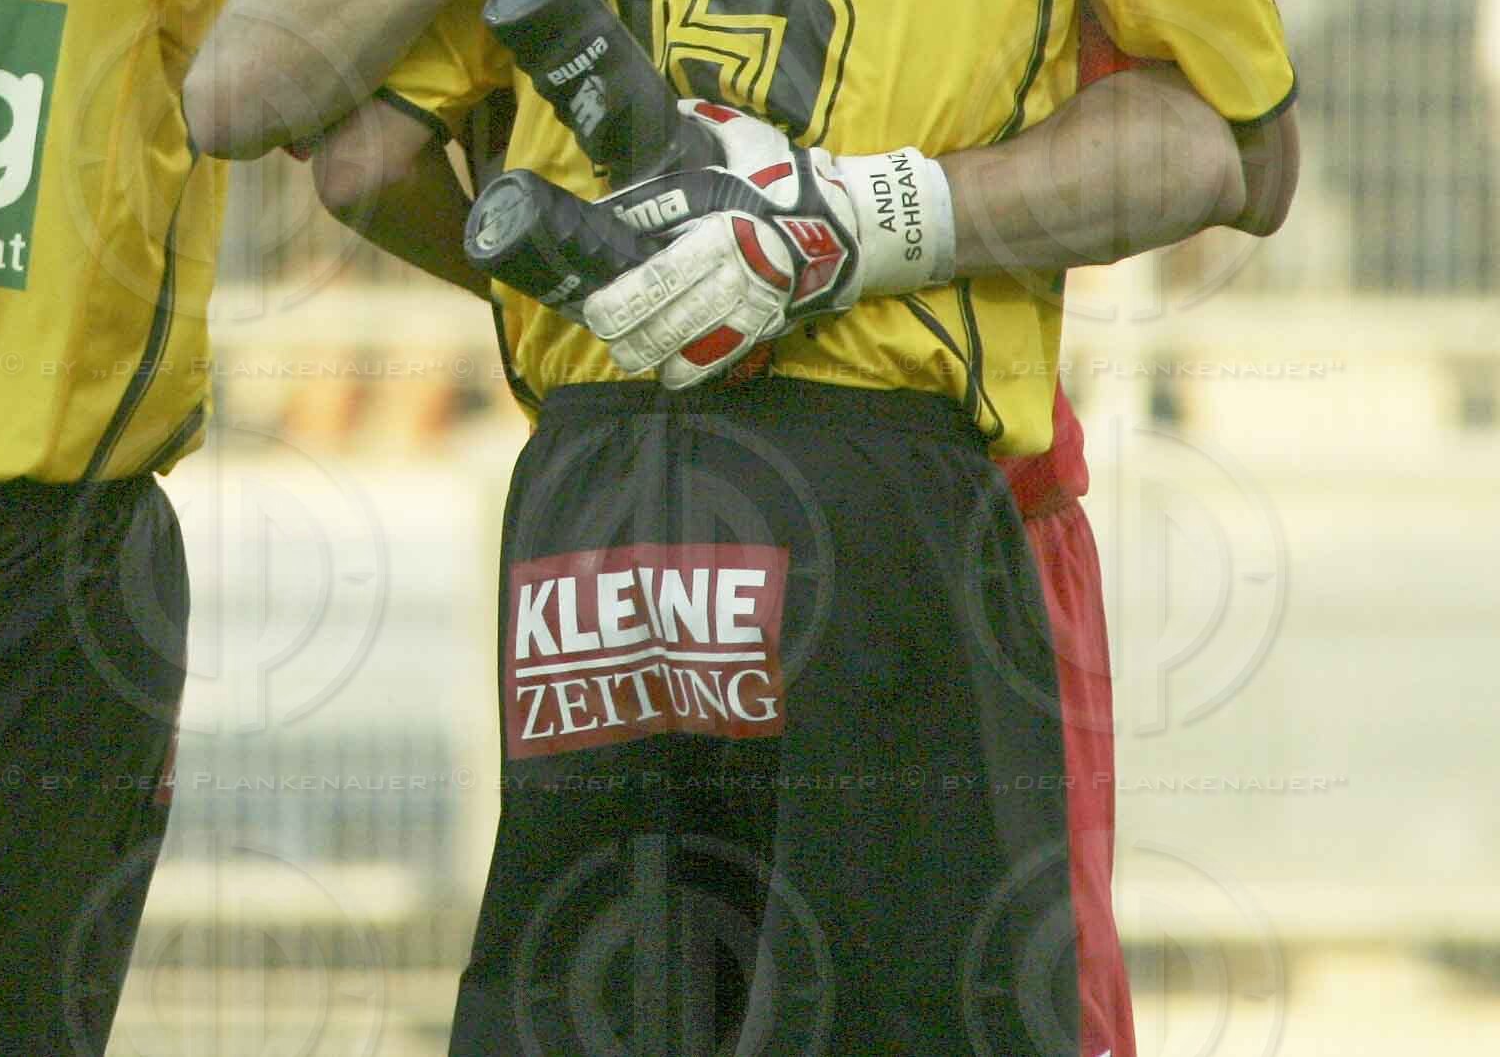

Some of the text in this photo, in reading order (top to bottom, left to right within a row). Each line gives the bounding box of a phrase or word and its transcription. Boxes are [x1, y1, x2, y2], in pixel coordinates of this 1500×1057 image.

[548, 36, 609, 86] erima
[613, 189, 690, 231] ima
[870, 173, 896, 233] ANDI
[515, 566, 767, 661] KLEINE
[516, 662, 779, 741] ZEITUNG
